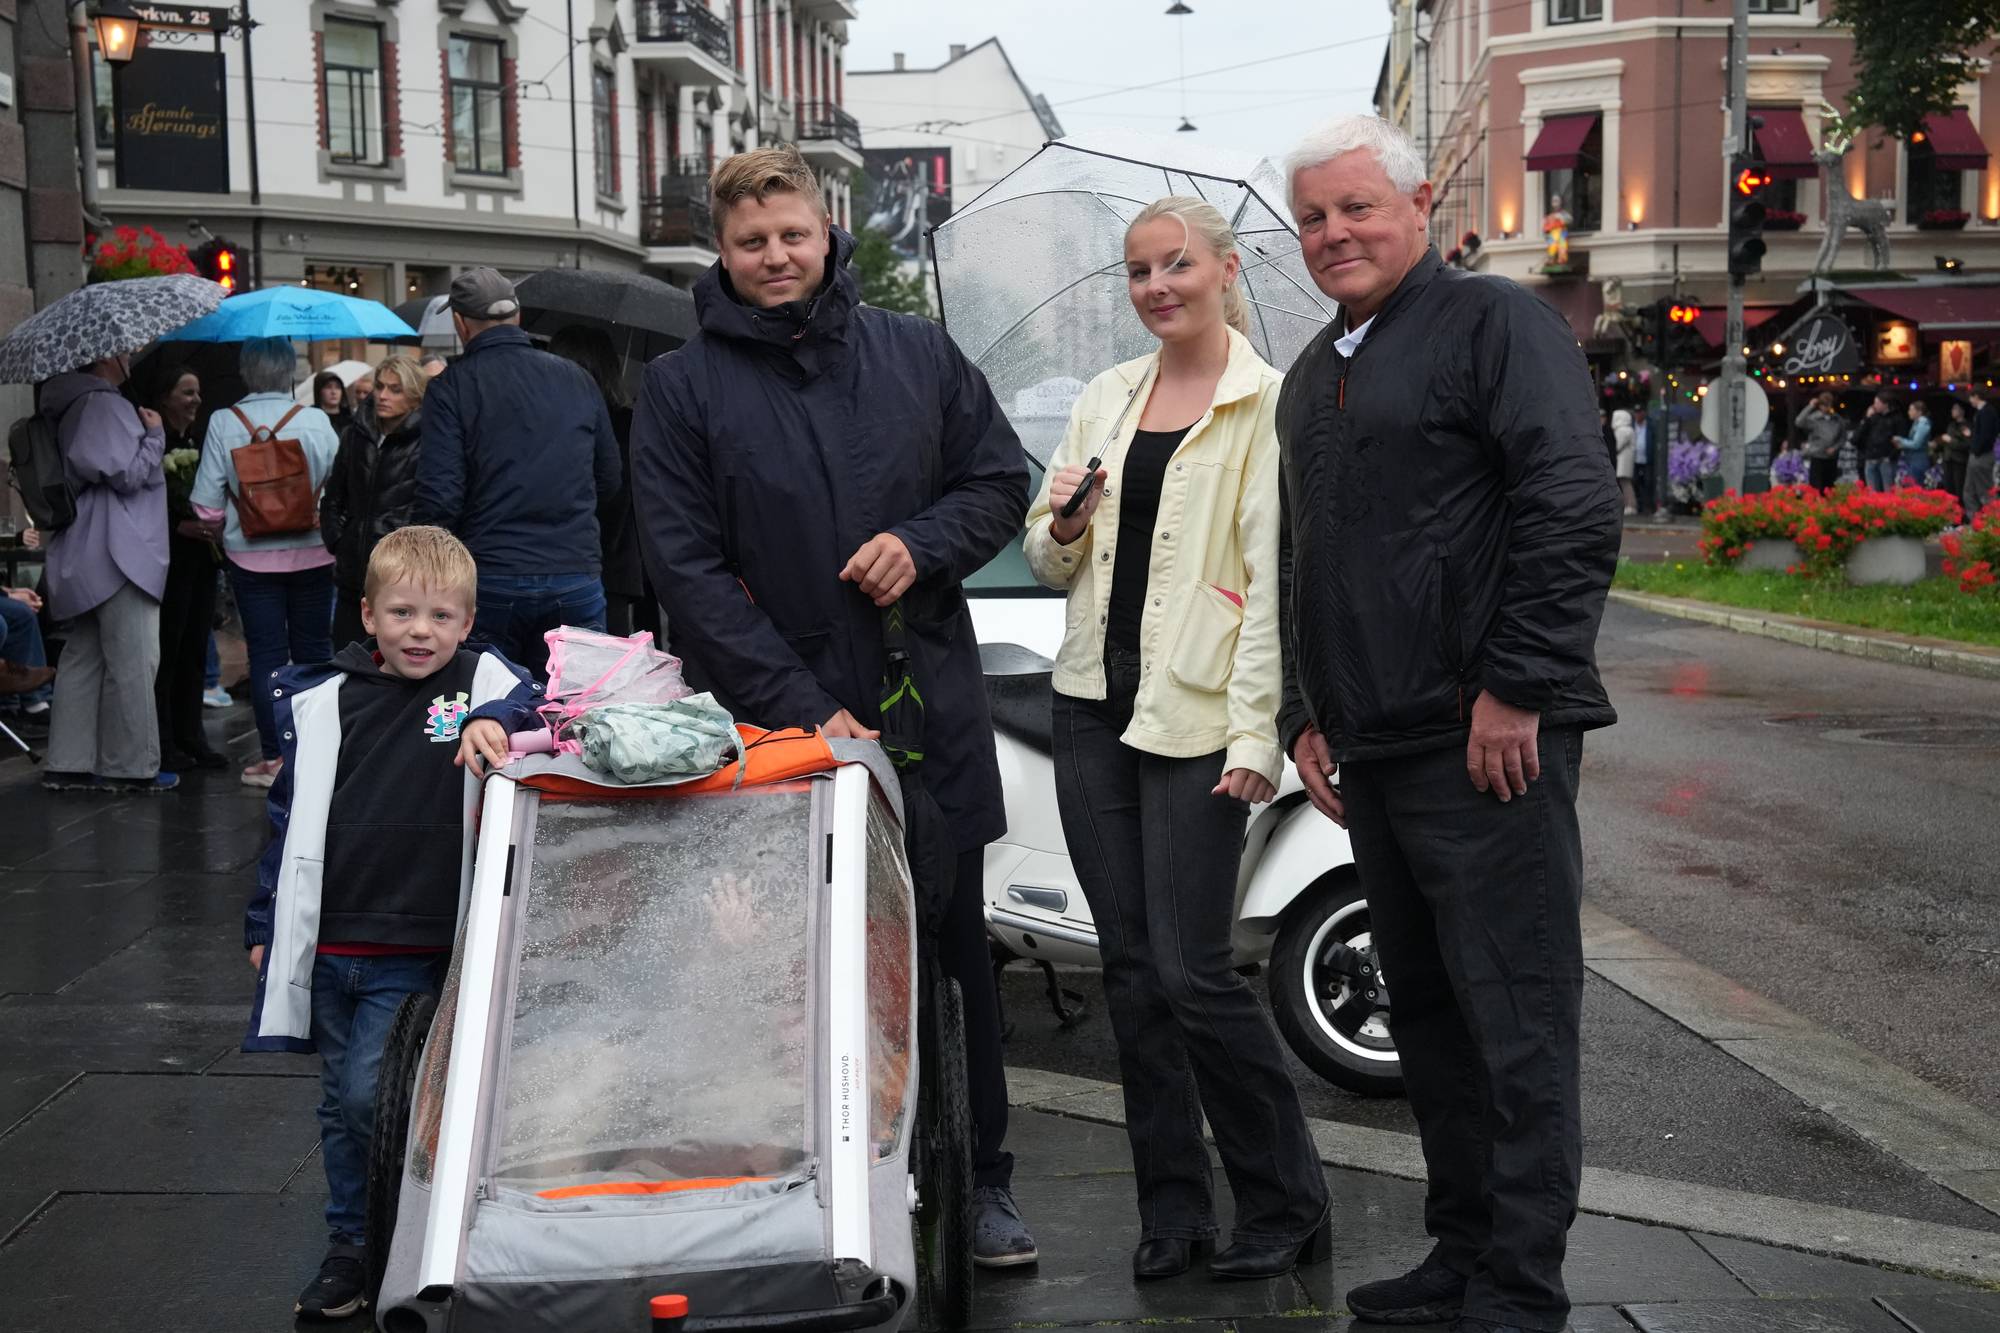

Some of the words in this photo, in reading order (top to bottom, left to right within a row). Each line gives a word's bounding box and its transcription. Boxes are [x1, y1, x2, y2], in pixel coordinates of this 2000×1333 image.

[190, 10, 211, 25] 25
[142, 101, 195, 120] Gamle
[842, 1104, 850, 1130] THOR
